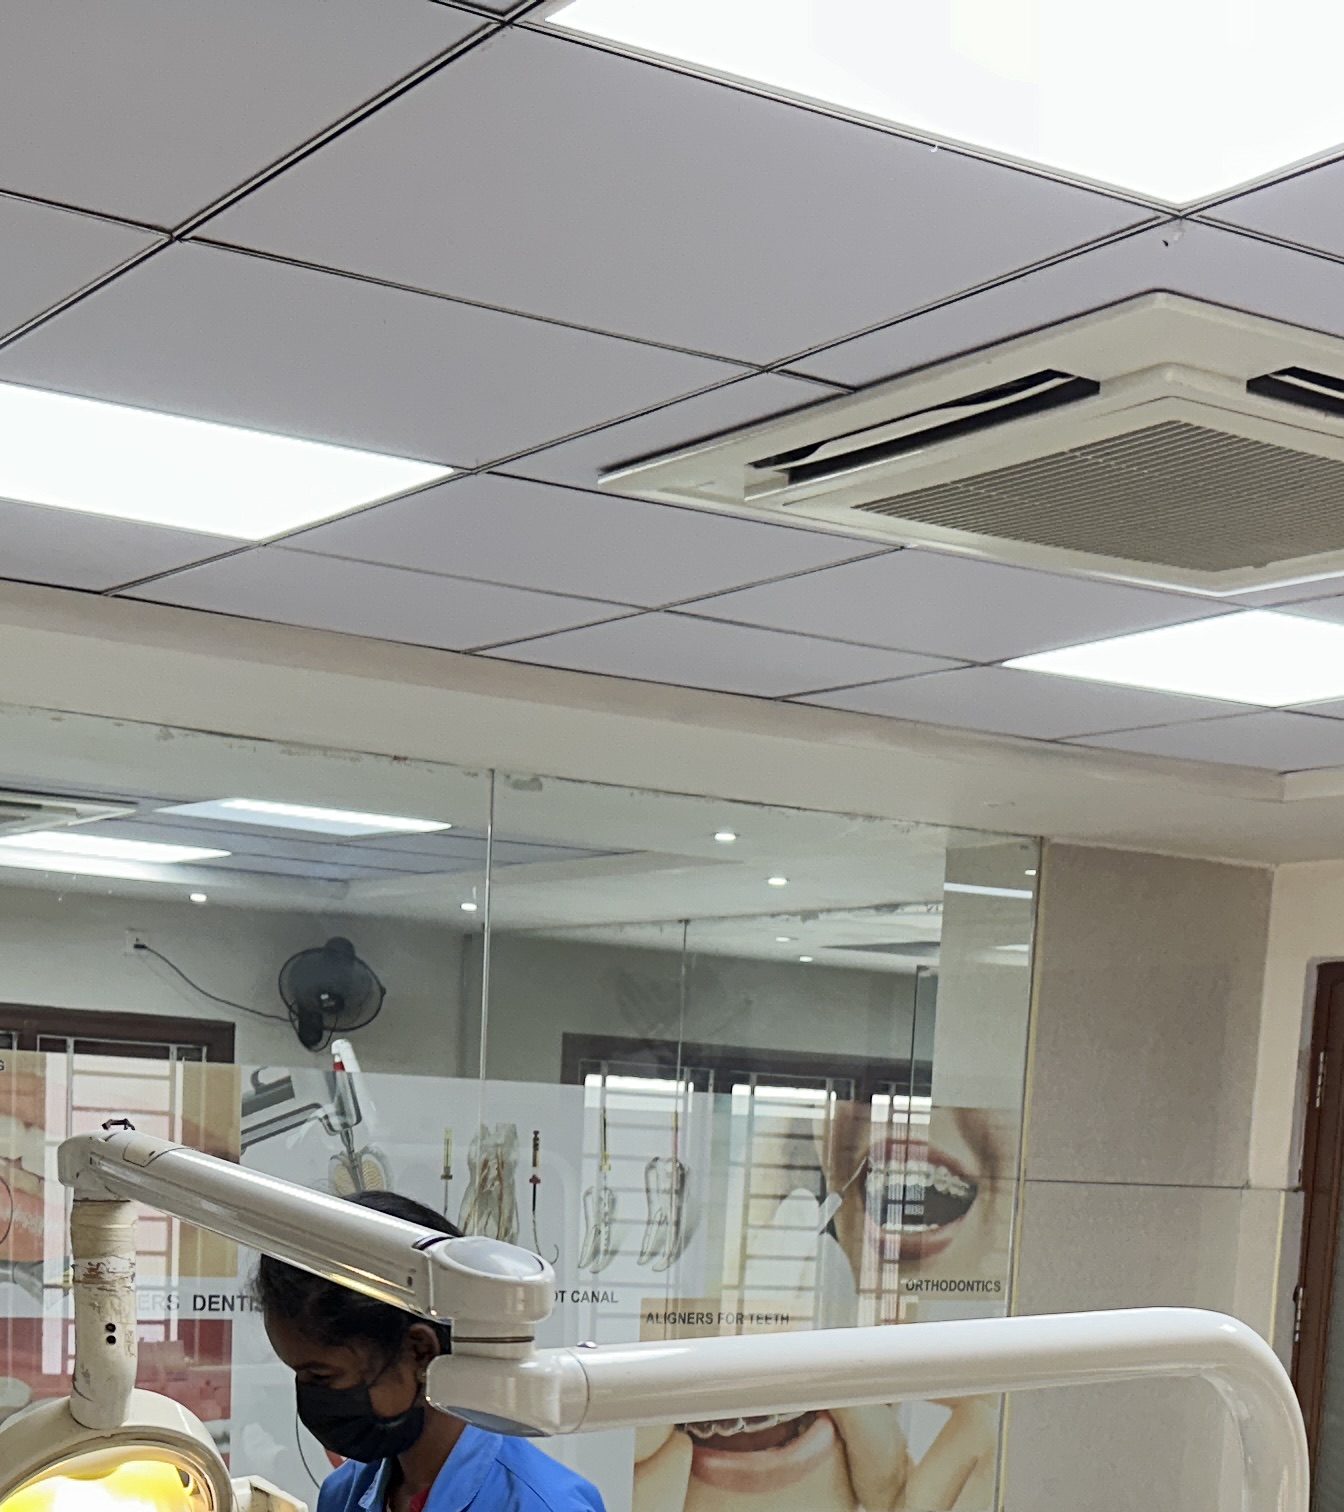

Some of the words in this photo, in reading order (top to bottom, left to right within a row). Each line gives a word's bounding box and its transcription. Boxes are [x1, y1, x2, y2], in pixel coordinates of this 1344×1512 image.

[905, 1278, 1002, 1293] ORTHODONTICS
[570, 1288, 620, 1304] CANAL
[645, 1310, 714, 1326] ALIGNERS
[717, 1311, 745, 1326] FOR
[748, 1311, 791, 1325] TEETH
